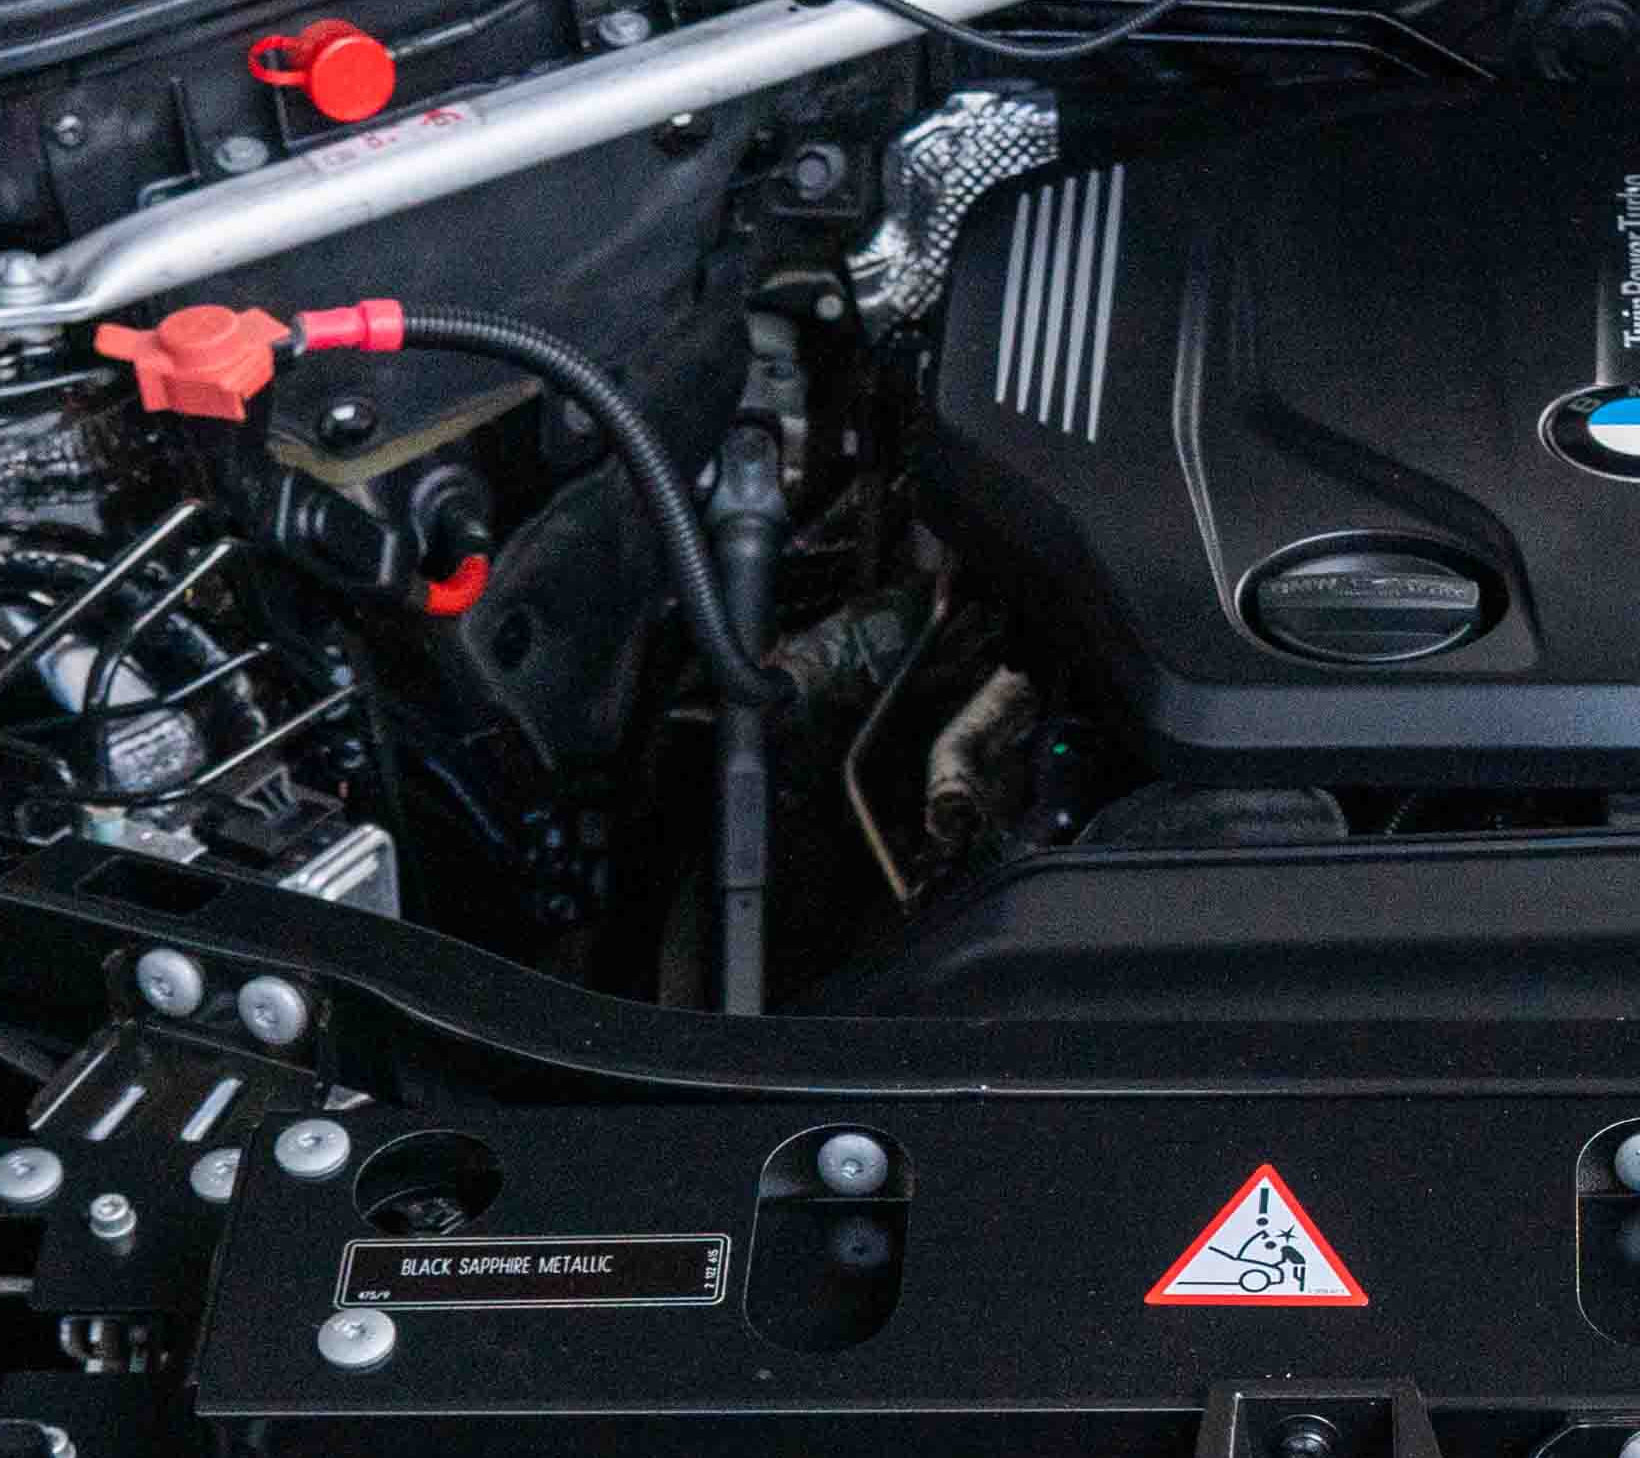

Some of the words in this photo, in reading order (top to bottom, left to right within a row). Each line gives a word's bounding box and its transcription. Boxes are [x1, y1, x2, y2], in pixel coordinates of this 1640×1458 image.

[400, 1257, 452, 1277] BLACK
[458, 1255, 532, 1276] SAPPHIRE
[538, 1254, 614, 1275] METALLIC
